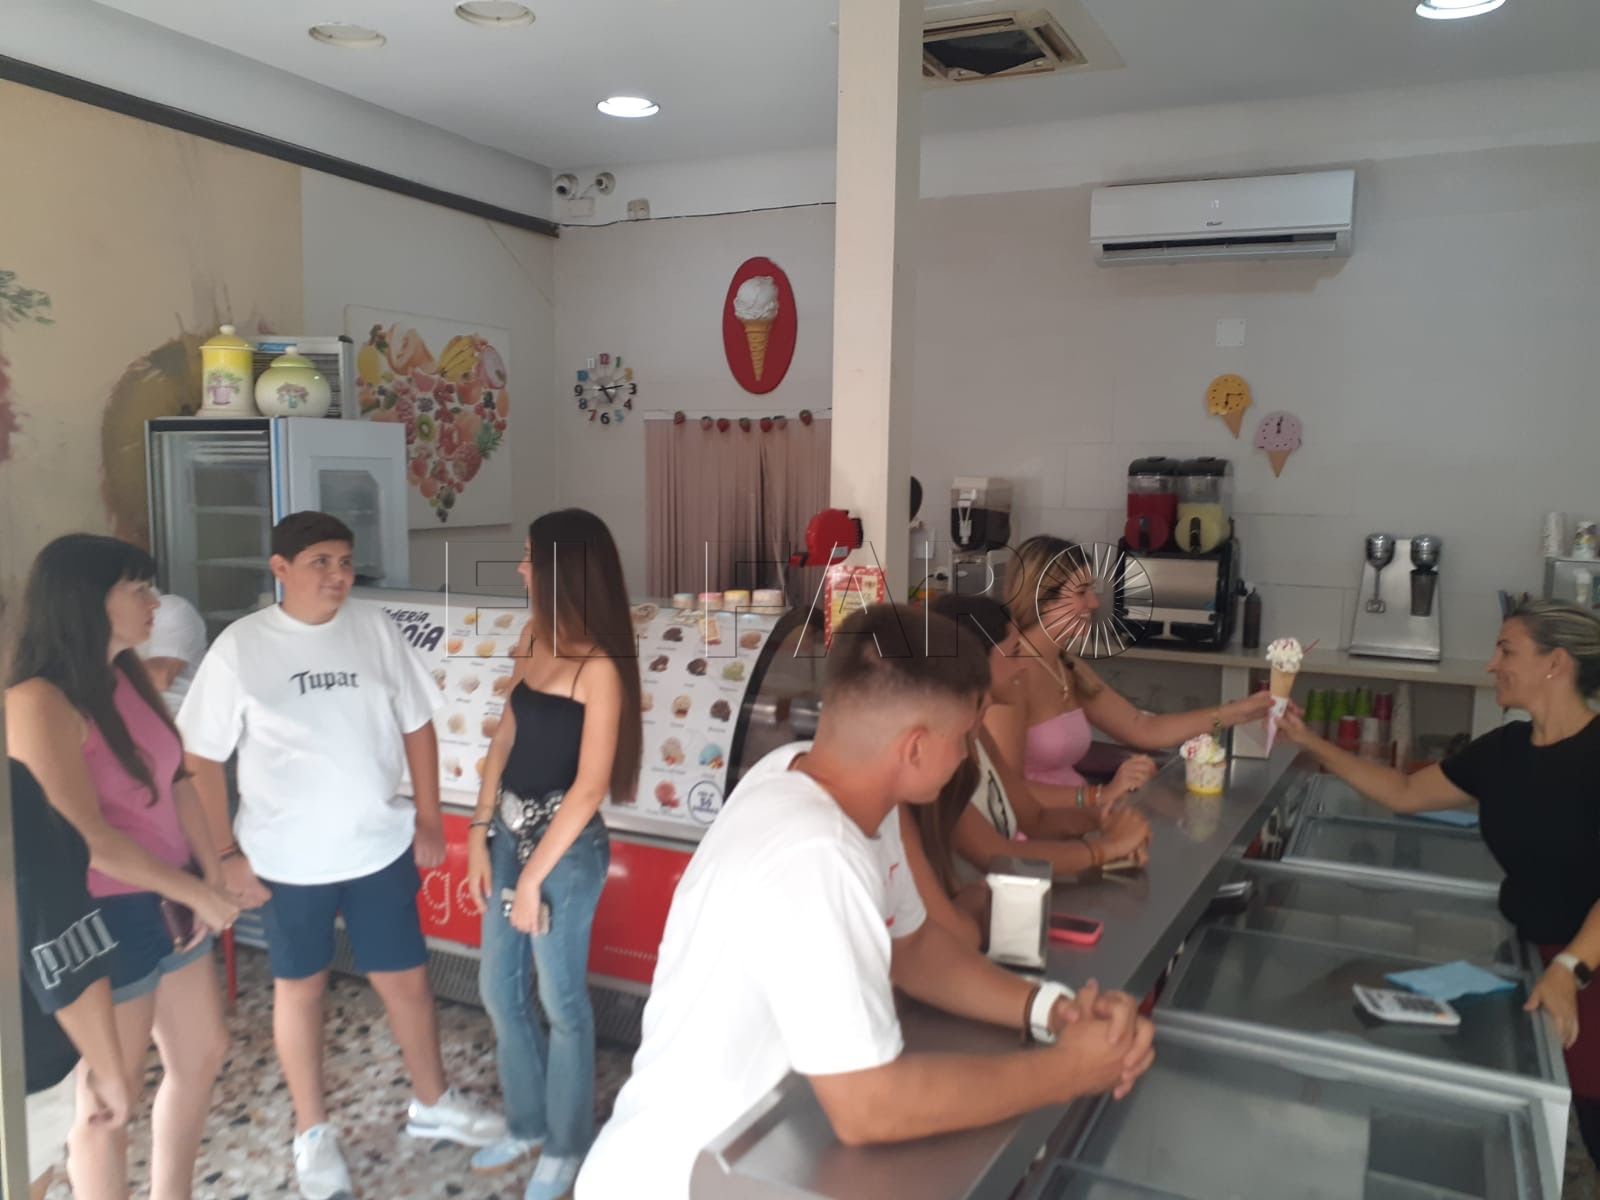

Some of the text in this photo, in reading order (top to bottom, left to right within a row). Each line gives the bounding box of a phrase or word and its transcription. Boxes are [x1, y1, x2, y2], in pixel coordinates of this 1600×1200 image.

[574, 384, 584, 397] 9
[629, 383, 637, 395] 3
[579, 398, 588, 410] 8
[587, 409, 597, 421] 7
[600, 412, 610, 425] 6
